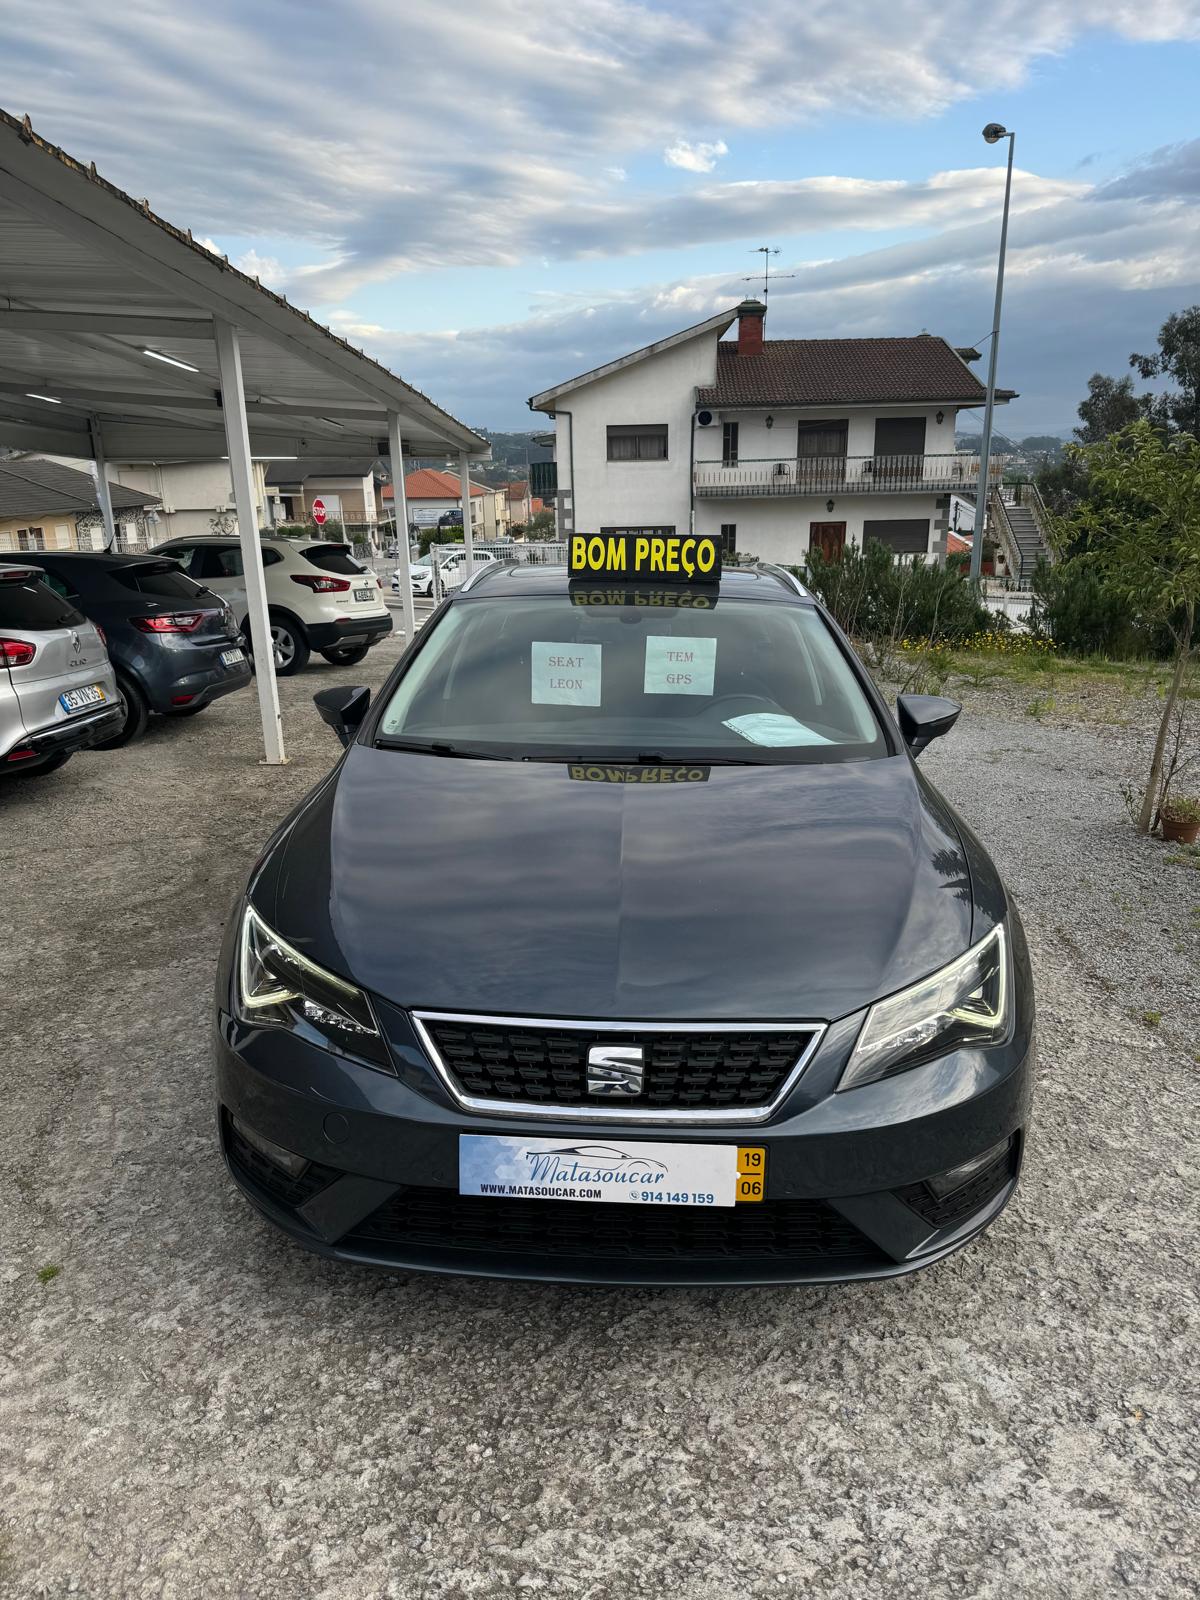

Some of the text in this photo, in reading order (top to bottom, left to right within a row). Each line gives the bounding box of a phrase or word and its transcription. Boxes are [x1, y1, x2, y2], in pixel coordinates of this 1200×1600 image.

[313, 507, 326, 517] STOP
[571, 536, 716, 579] BOM PREÇO
[69, 658, 87, 667] CLIO
[548, 656, 585, 669] SEAT
[666, 651, 694, 663] TEM
[549, 678, 583, 690] LEON
[666, 673, 693, 685] GPS
[744, 1152, 761, 1167] 19
[529, 1153, 665, 1184] Matasoucar
[480, 1183, 602, 1199] WWW.MATASOUCAR.COM
[741, 1181, 761, 1195] 06
[641, 1191, 714, 1204] 914 149 159
